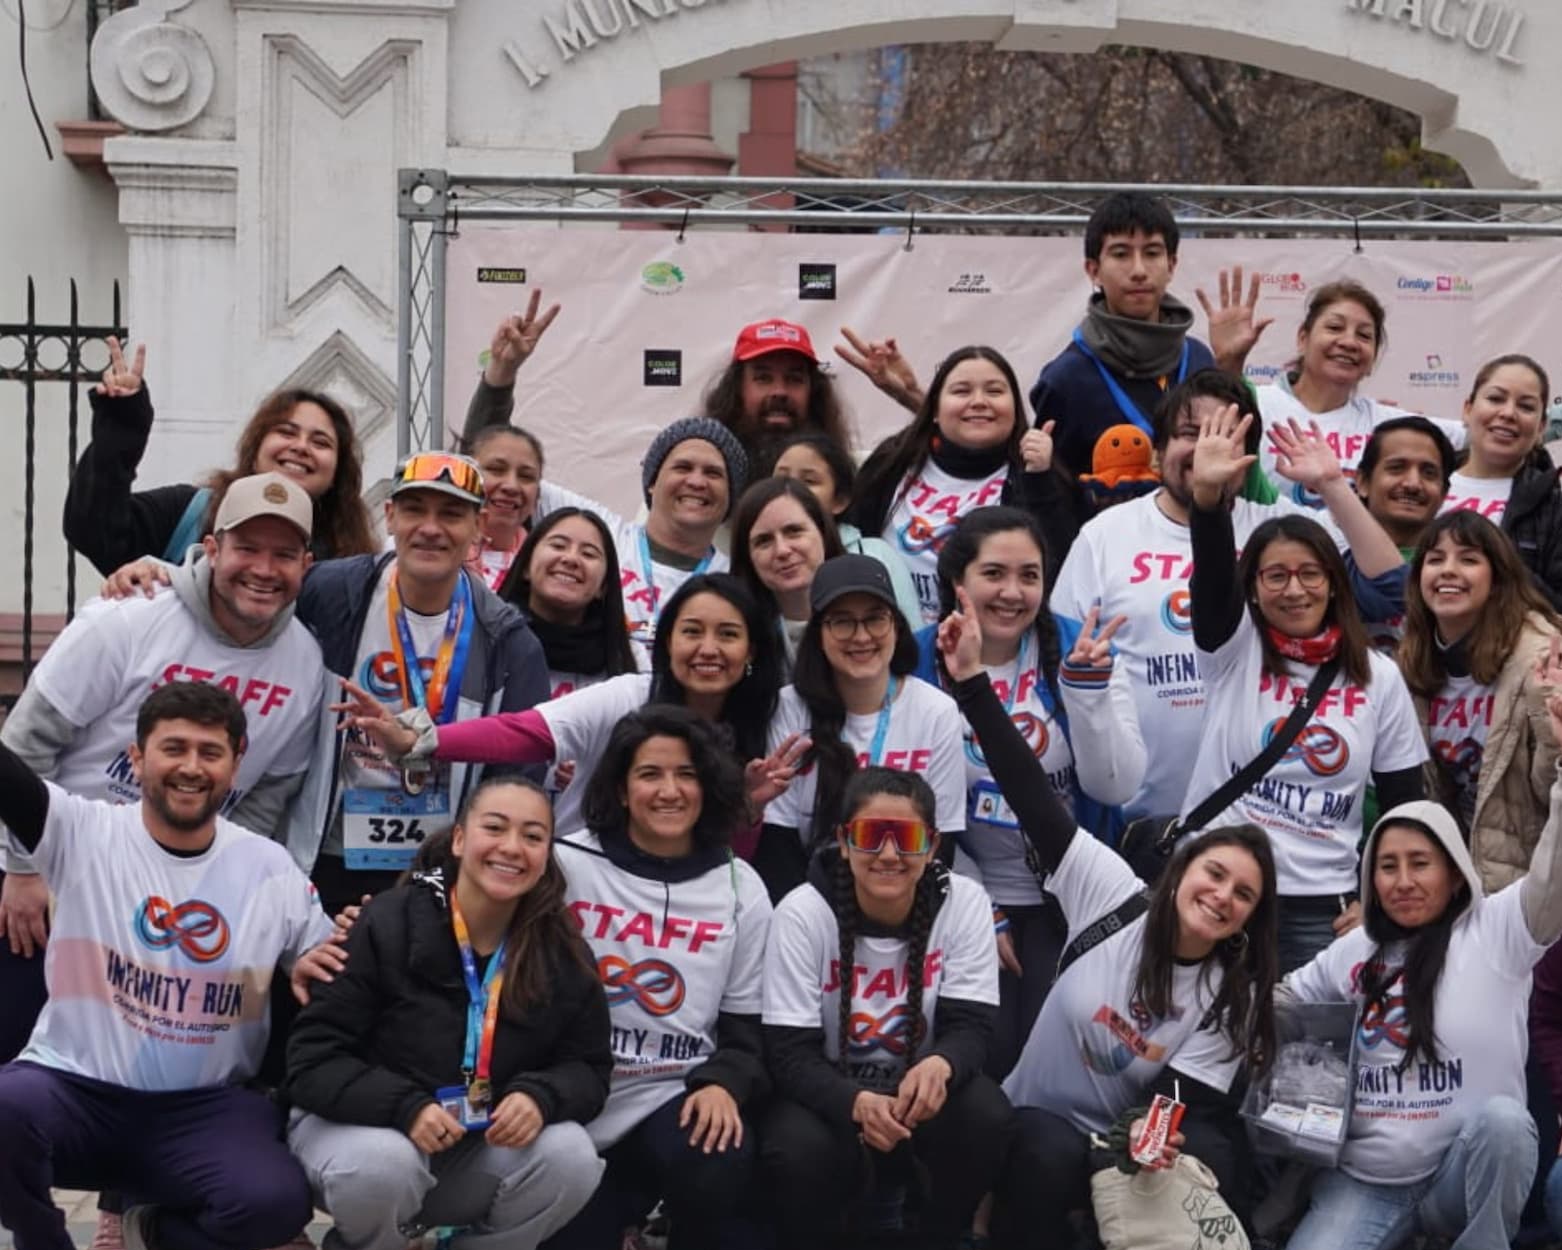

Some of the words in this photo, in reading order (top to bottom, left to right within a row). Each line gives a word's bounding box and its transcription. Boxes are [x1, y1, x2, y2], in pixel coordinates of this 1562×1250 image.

[1409, 370, 1459, 384] espress
[369, 818, 426, 843] 324
[106, 949, 191, 1014] INFINITY
[203, 982, 244, 1017] RUN
[660, 1032, 705, 1060] RUN
[1420, 1058, 1464, 1093] RUN
